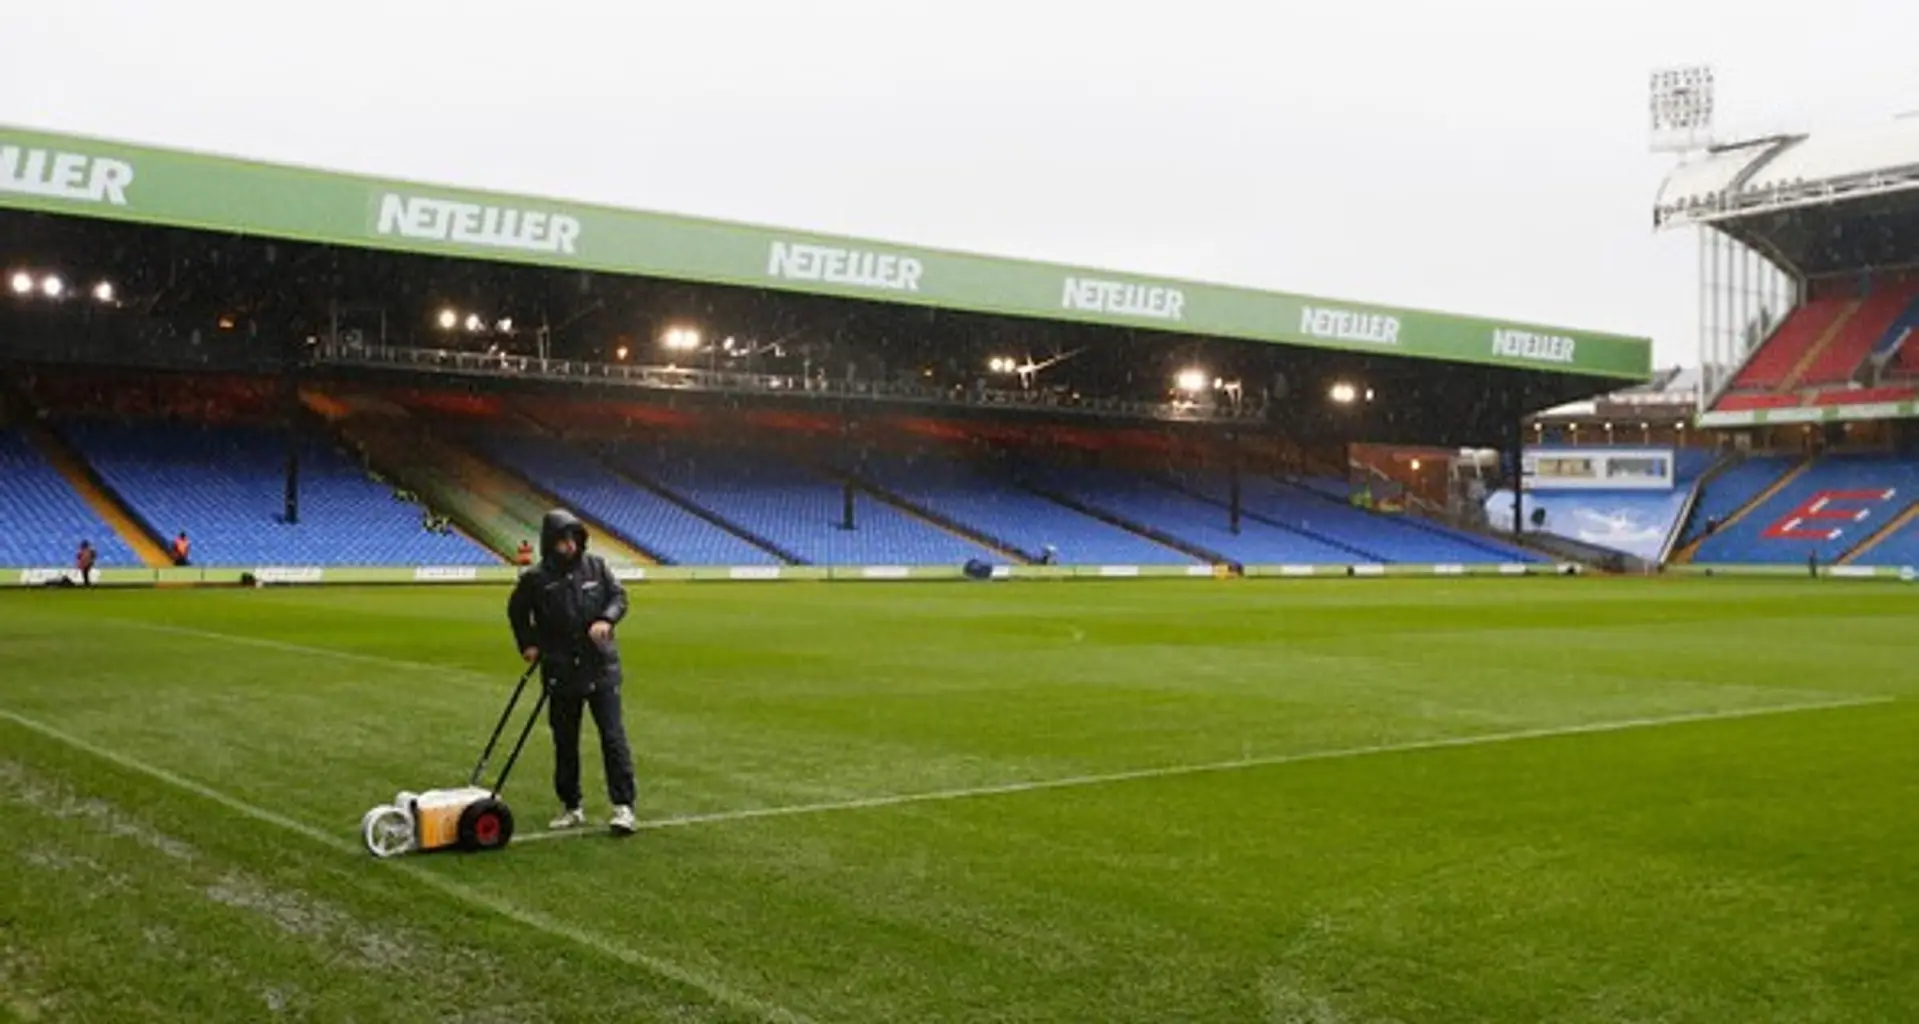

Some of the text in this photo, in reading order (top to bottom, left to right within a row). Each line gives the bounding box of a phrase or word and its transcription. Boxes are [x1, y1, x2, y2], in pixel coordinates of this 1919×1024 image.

[379, 193, 578, 254] NETELLER
[769, 242, 922, 290] NETELLER
[1063, 278, 1183, 319] NETELLER
[1302, 306, 1399, 342] NETELLER
[1493, 328, 1574, 362] NETELLER
[1761, 488, 1896, 539] E
